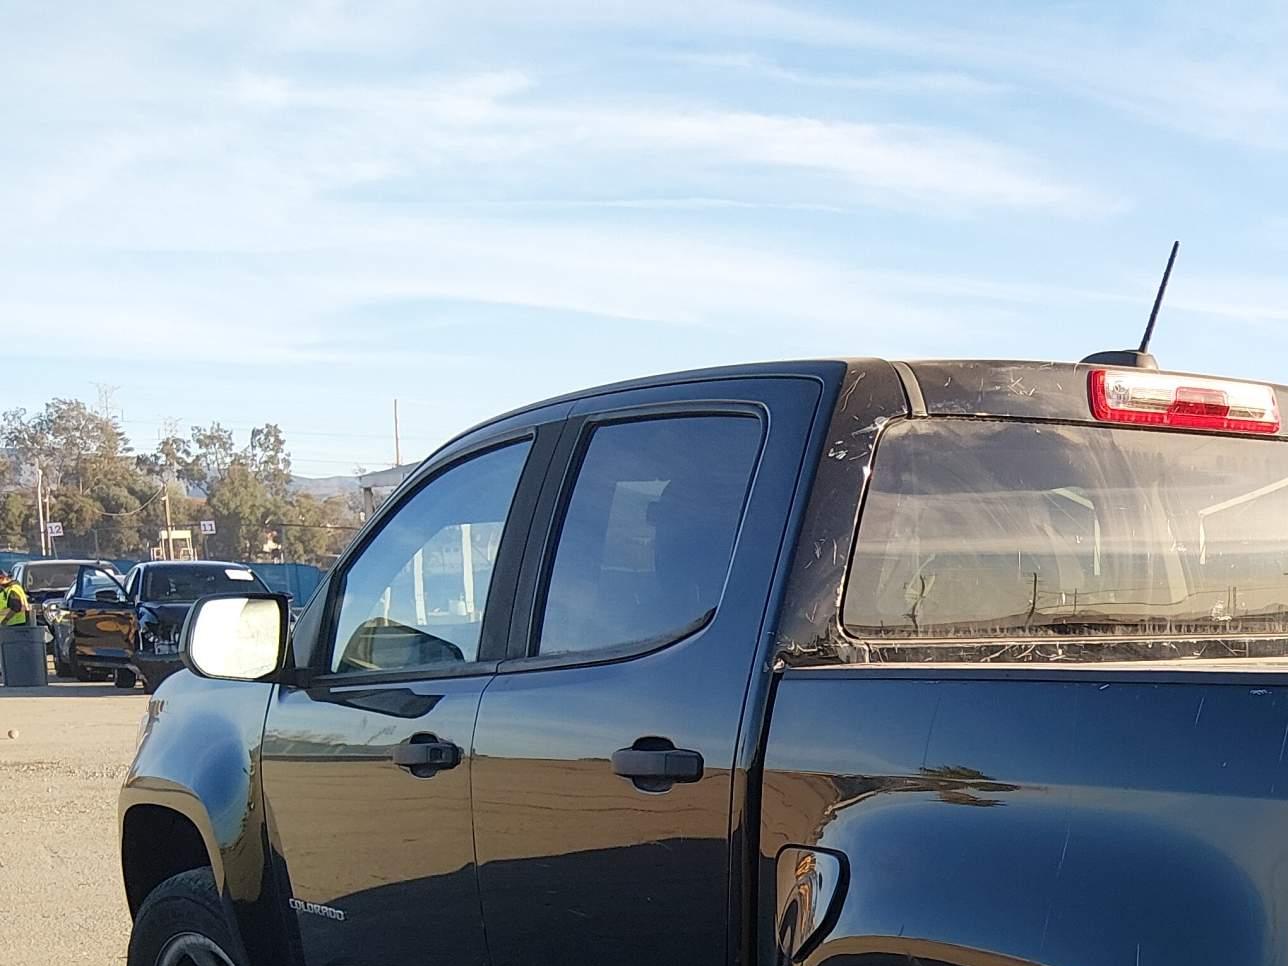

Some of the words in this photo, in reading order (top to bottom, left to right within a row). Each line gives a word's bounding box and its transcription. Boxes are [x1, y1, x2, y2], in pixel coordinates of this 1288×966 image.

[49, 525, 62, 534] 12
[203, 523, 213, 532] 11
[288, 898, 345, 920] COLORADO
